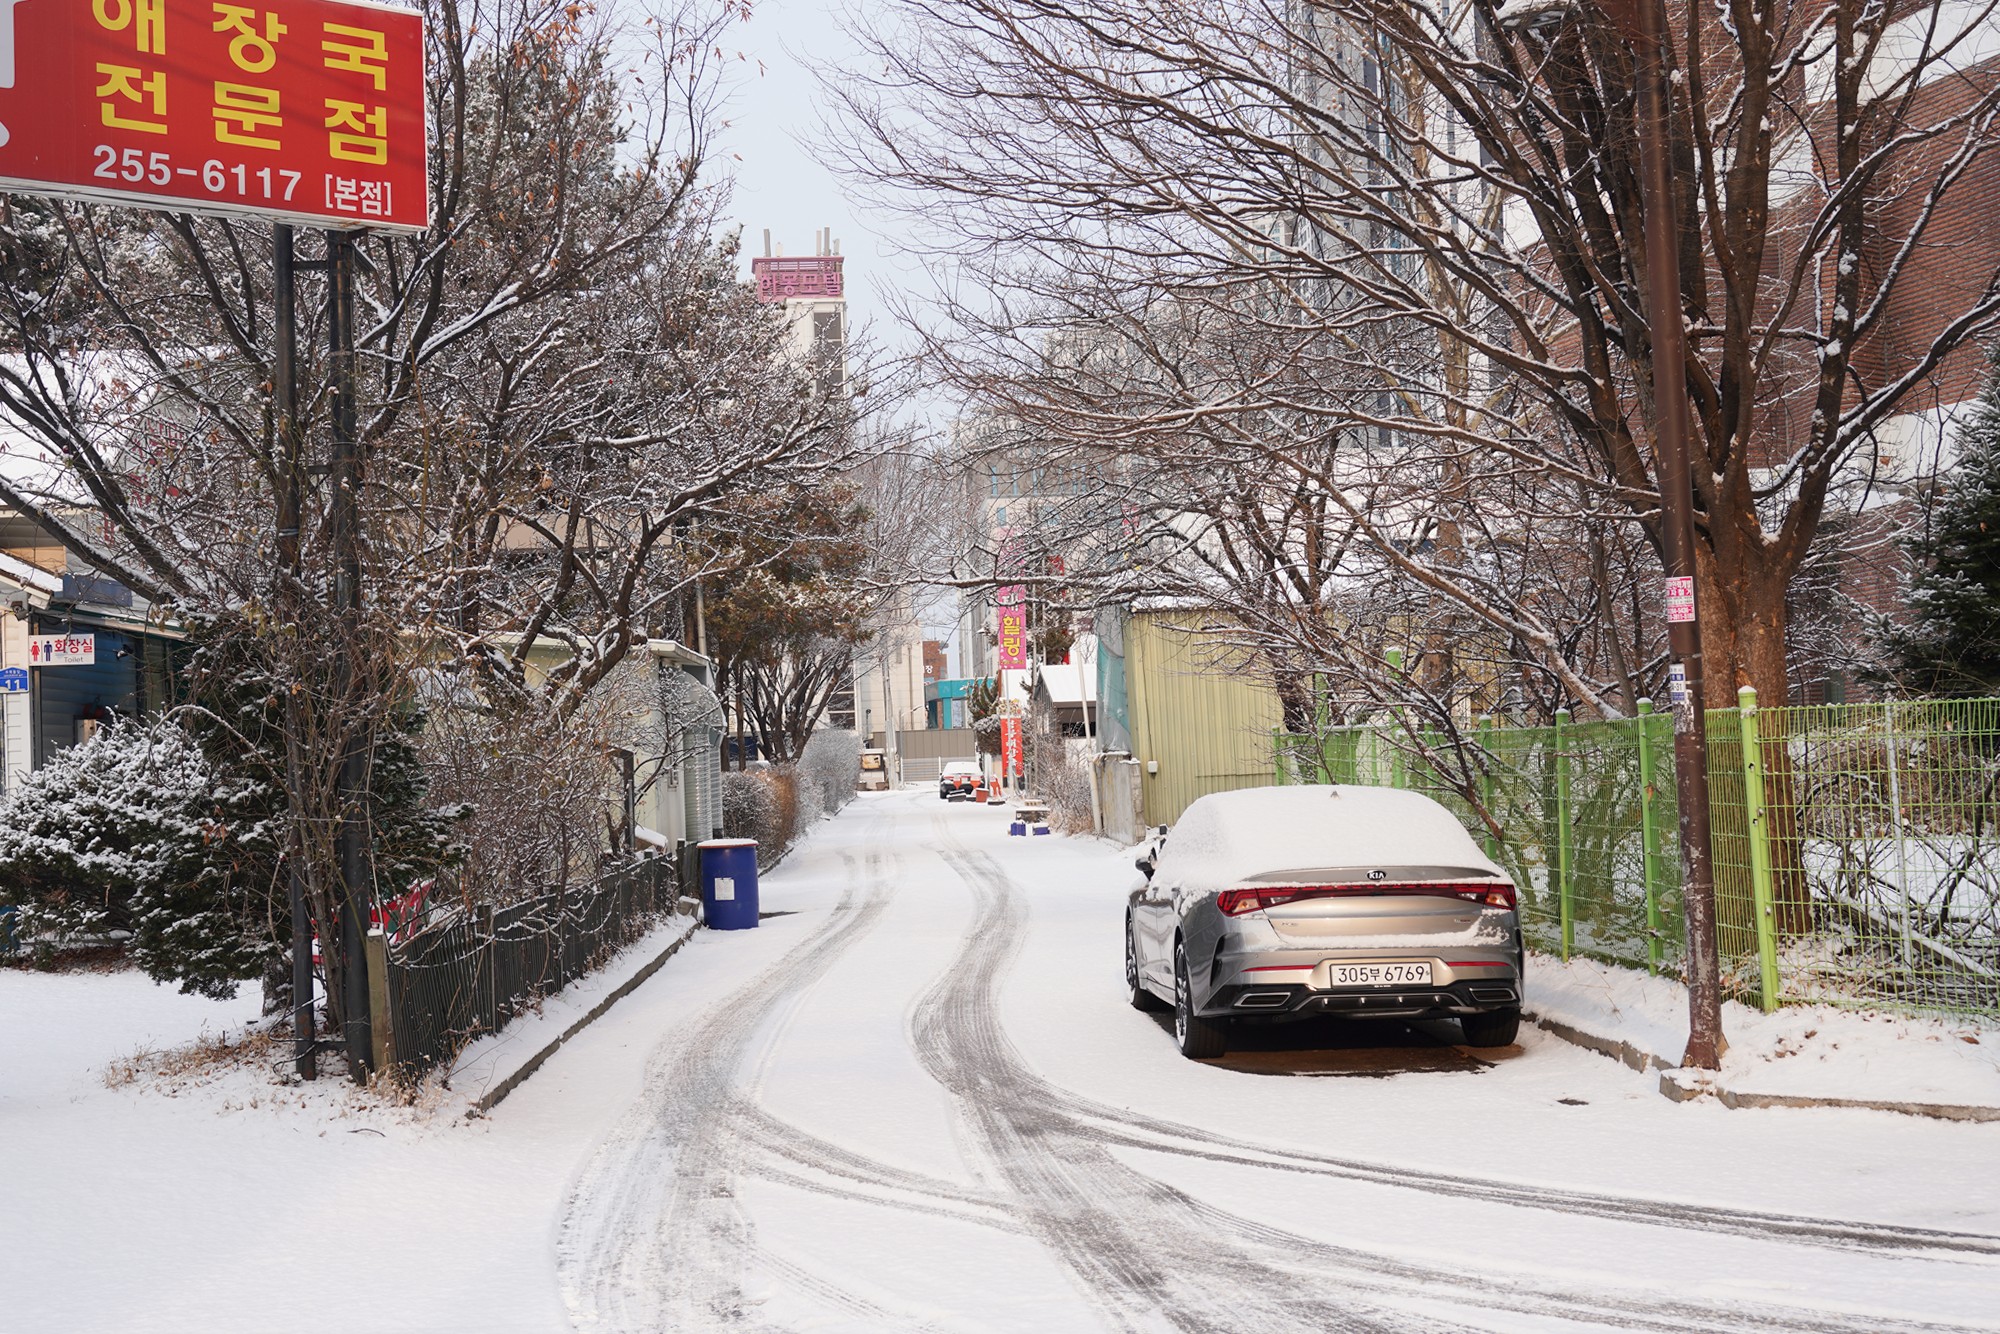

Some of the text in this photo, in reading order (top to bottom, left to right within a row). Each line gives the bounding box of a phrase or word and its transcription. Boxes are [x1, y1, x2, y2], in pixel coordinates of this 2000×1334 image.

[96, 62, 388, 166] 전문점
[93, 144, 392, 216] 255-6117 [본점]
[1003, 616, 1020, 657] 힐링
[54, 638, 93, 654] 화장실
[64, 655, 83, 663] Toilet
[5, 679, 20, 690] 11
[1368, 871, 1385, 880] KIA
[1338, 965, 1425, 983] 305부 6769
